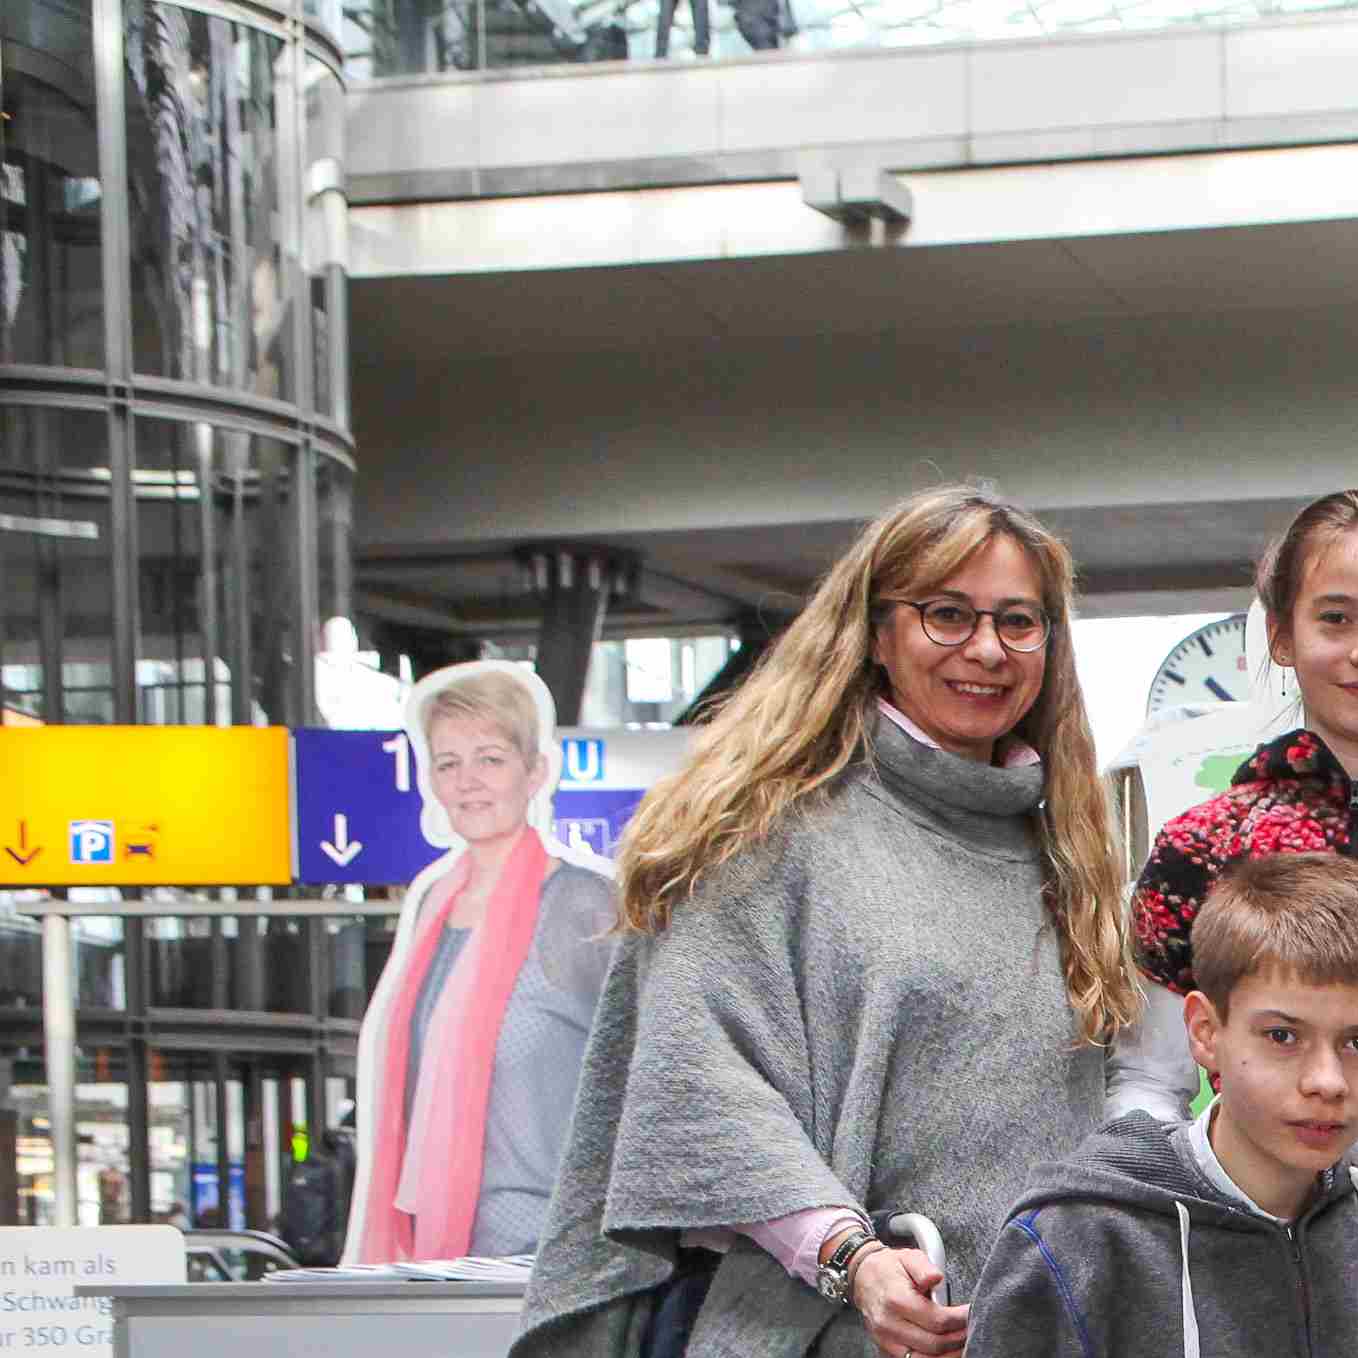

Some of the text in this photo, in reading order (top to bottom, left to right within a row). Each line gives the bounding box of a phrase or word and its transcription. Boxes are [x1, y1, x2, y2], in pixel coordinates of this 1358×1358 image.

[24, 1254, 75, 1276] kam
[83, 1252, 117, 1275] als
[23, 1327, 66, 1346] 350
